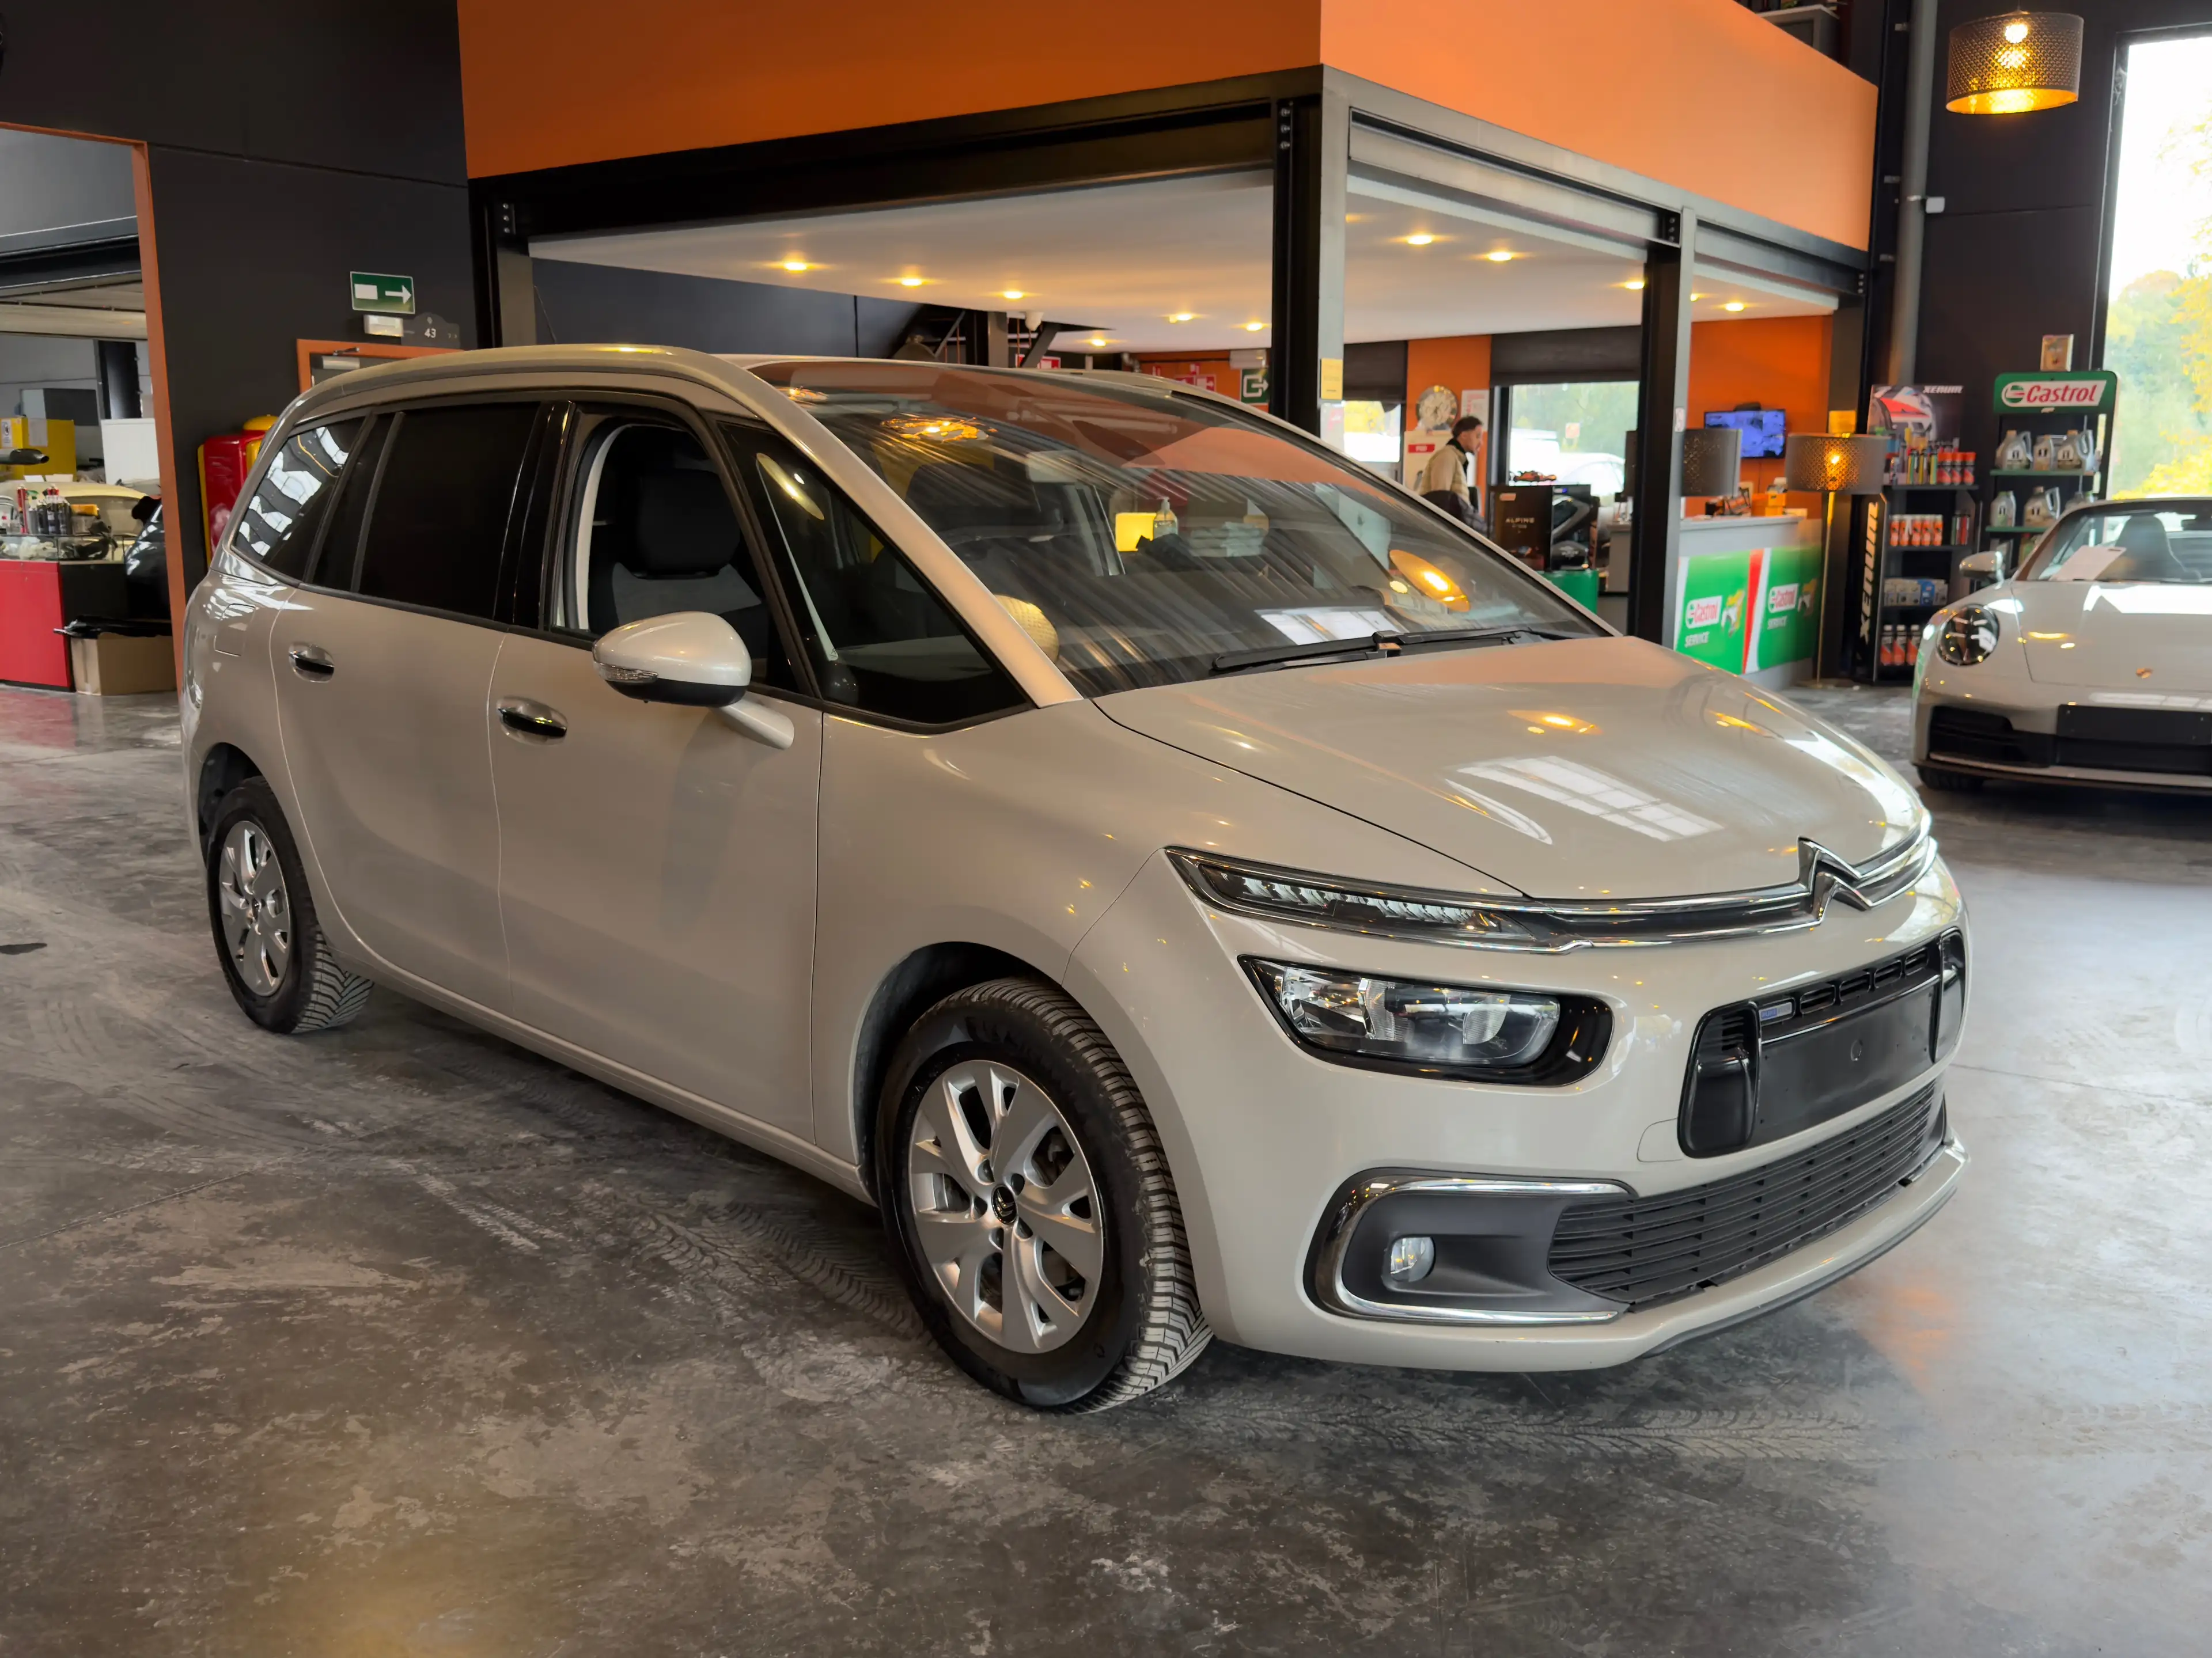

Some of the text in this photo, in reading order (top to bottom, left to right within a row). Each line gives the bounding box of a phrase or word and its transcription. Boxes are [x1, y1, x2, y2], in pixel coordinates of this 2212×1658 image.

[424, 328, 436, 339] 43
[2027, 385, 2097, 403] Castrol
[1775, 589, 1796, 608] Castrol
[1694, 603, 1718, 623] Castrol
[1684, 631, 1710, 648] SERVICE
